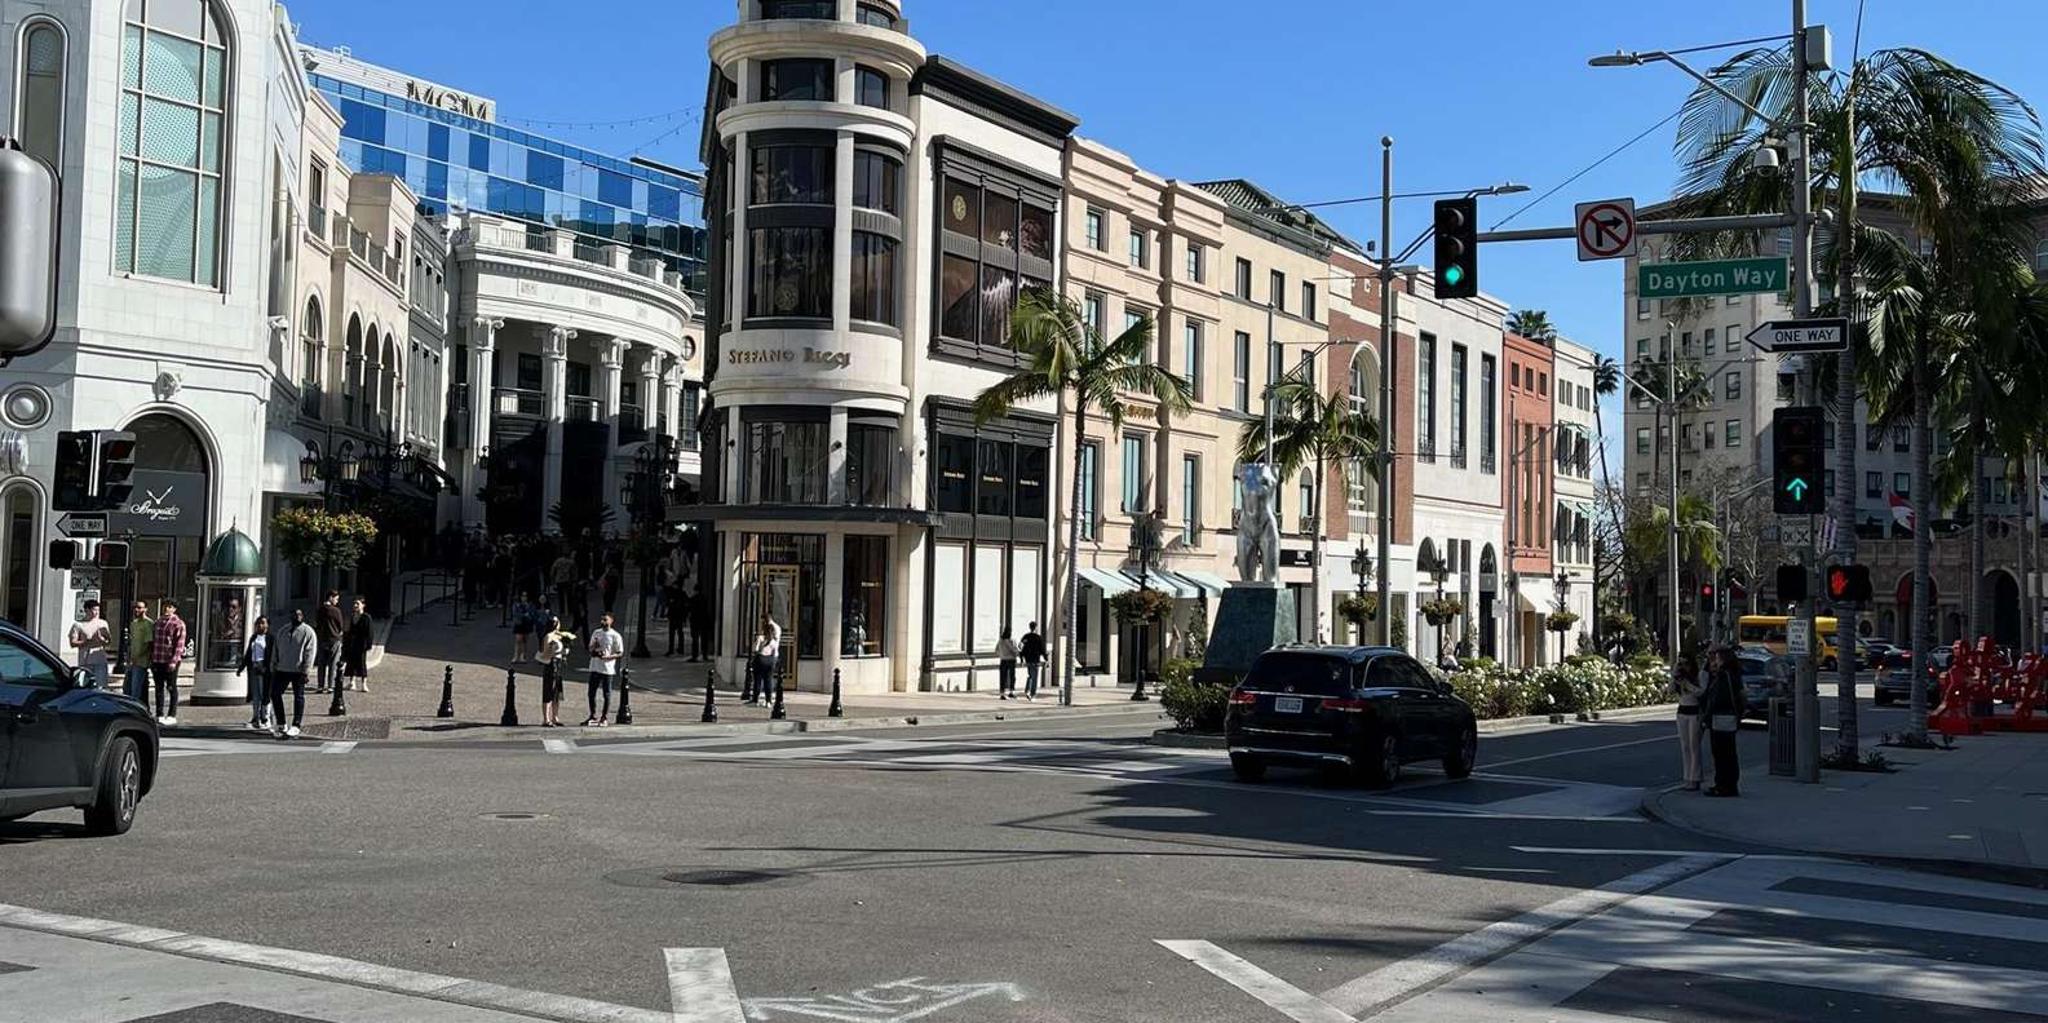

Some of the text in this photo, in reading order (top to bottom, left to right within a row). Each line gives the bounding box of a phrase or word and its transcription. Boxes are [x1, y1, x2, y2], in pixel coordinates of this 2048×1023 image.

[407, 80, 489, 120] MGM
[1649, 267, 1776, 293] Dayton Way
[1775, 328, 1834, 342] ONE WAY
[729, 346, 851, 370] STEFANO RICCI
[71, 520, 102, 530] ONE WAY
